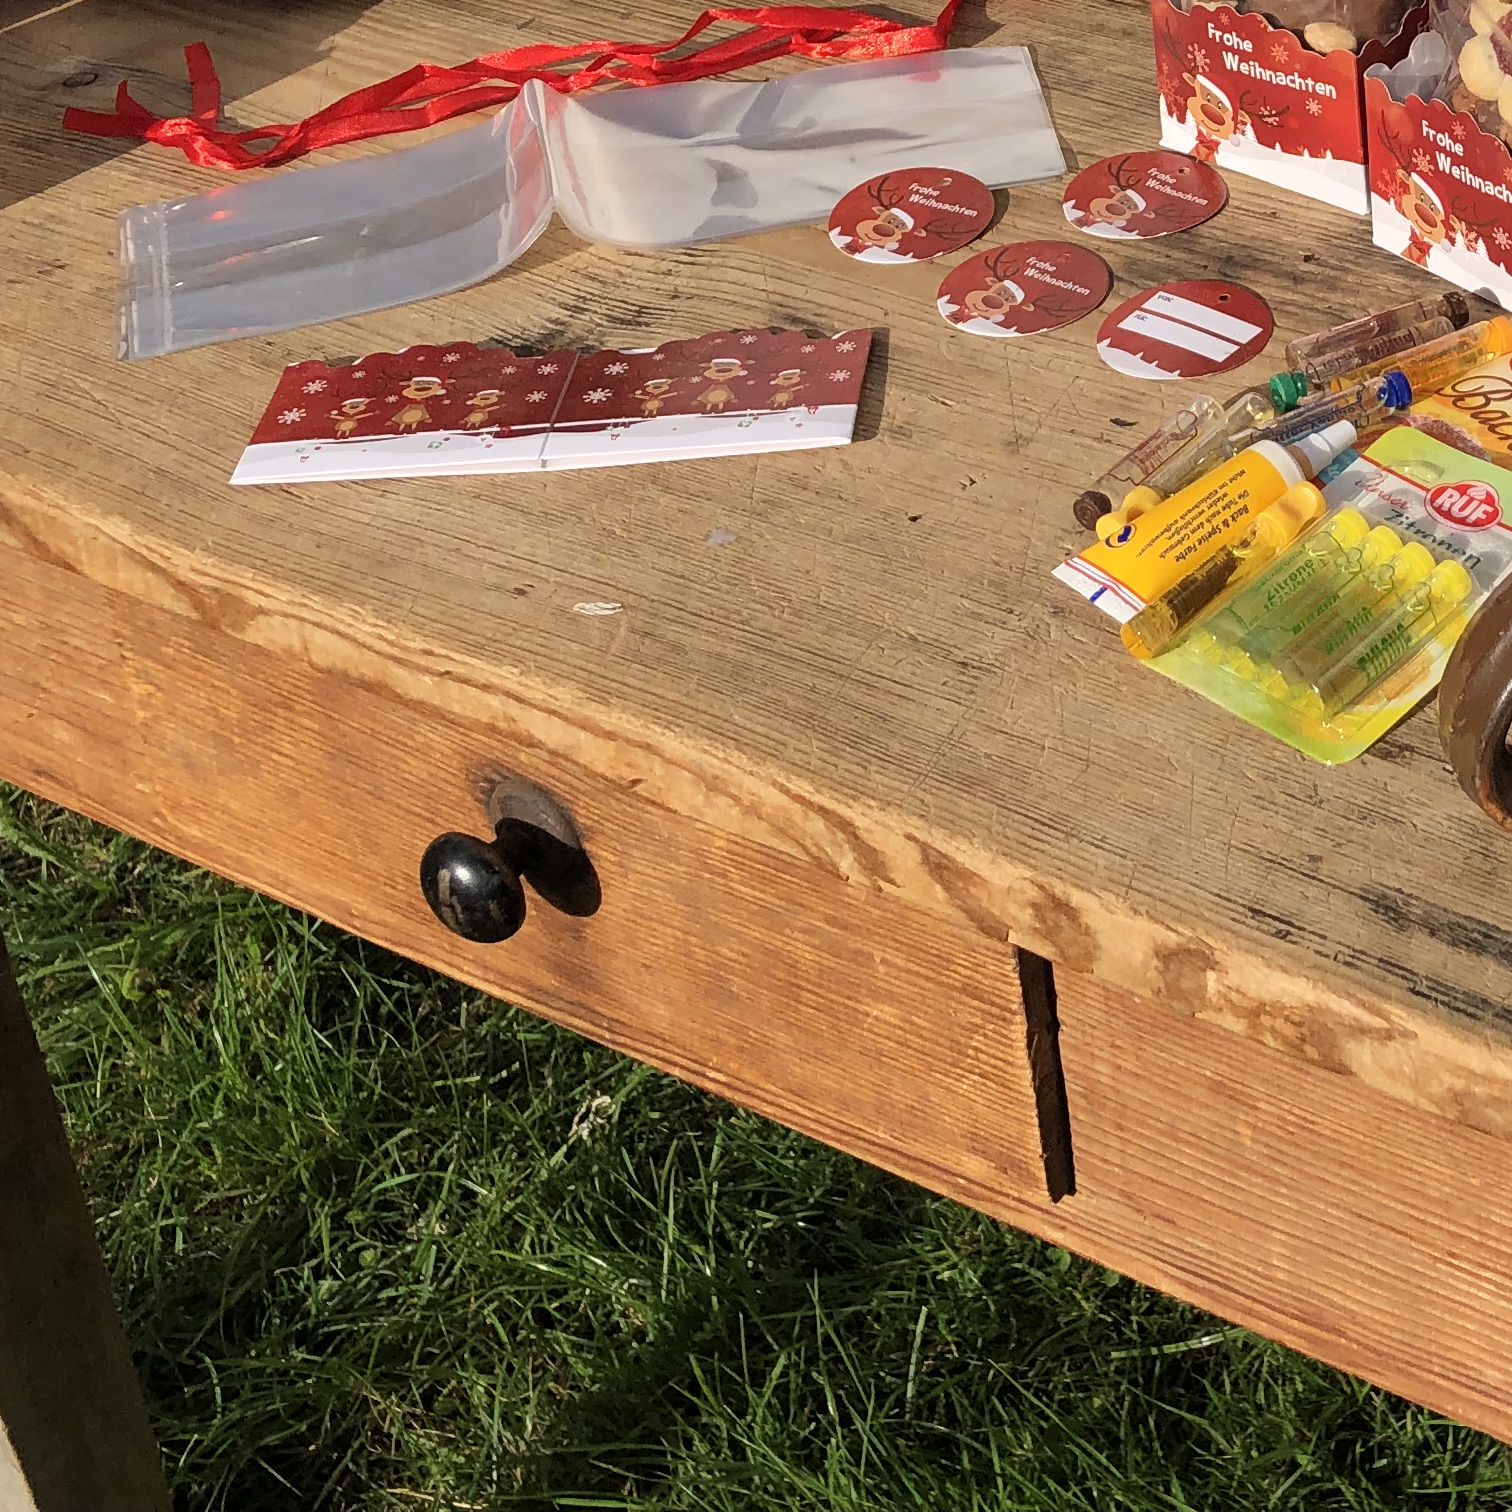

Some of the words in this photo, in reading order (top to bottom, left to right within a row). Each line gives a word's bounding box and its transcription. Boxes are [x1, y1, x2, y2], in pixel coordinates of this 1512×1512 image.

[1207, 22, 1253, 53] Frohe
[1222, 50, 1337, 100] Weihnachten
[1421, 119, 1464, 157] Frohe
[908, 182, 940, 196] Frohe
[1147, 167, 1177, 184] Frohe
[908, 193, 978, 217] Weihnachten
[1145, 178, 1208, 206] Weihnachten
[1025, 256, 1057, 272] Frohe
[1023, 267, 1091, 295] Weihnachten
[1229, 503, 1250, 523] Back
[1433, 488, 1494, 524] RUF
[1266, 558, 1314, 602] Zitrone
